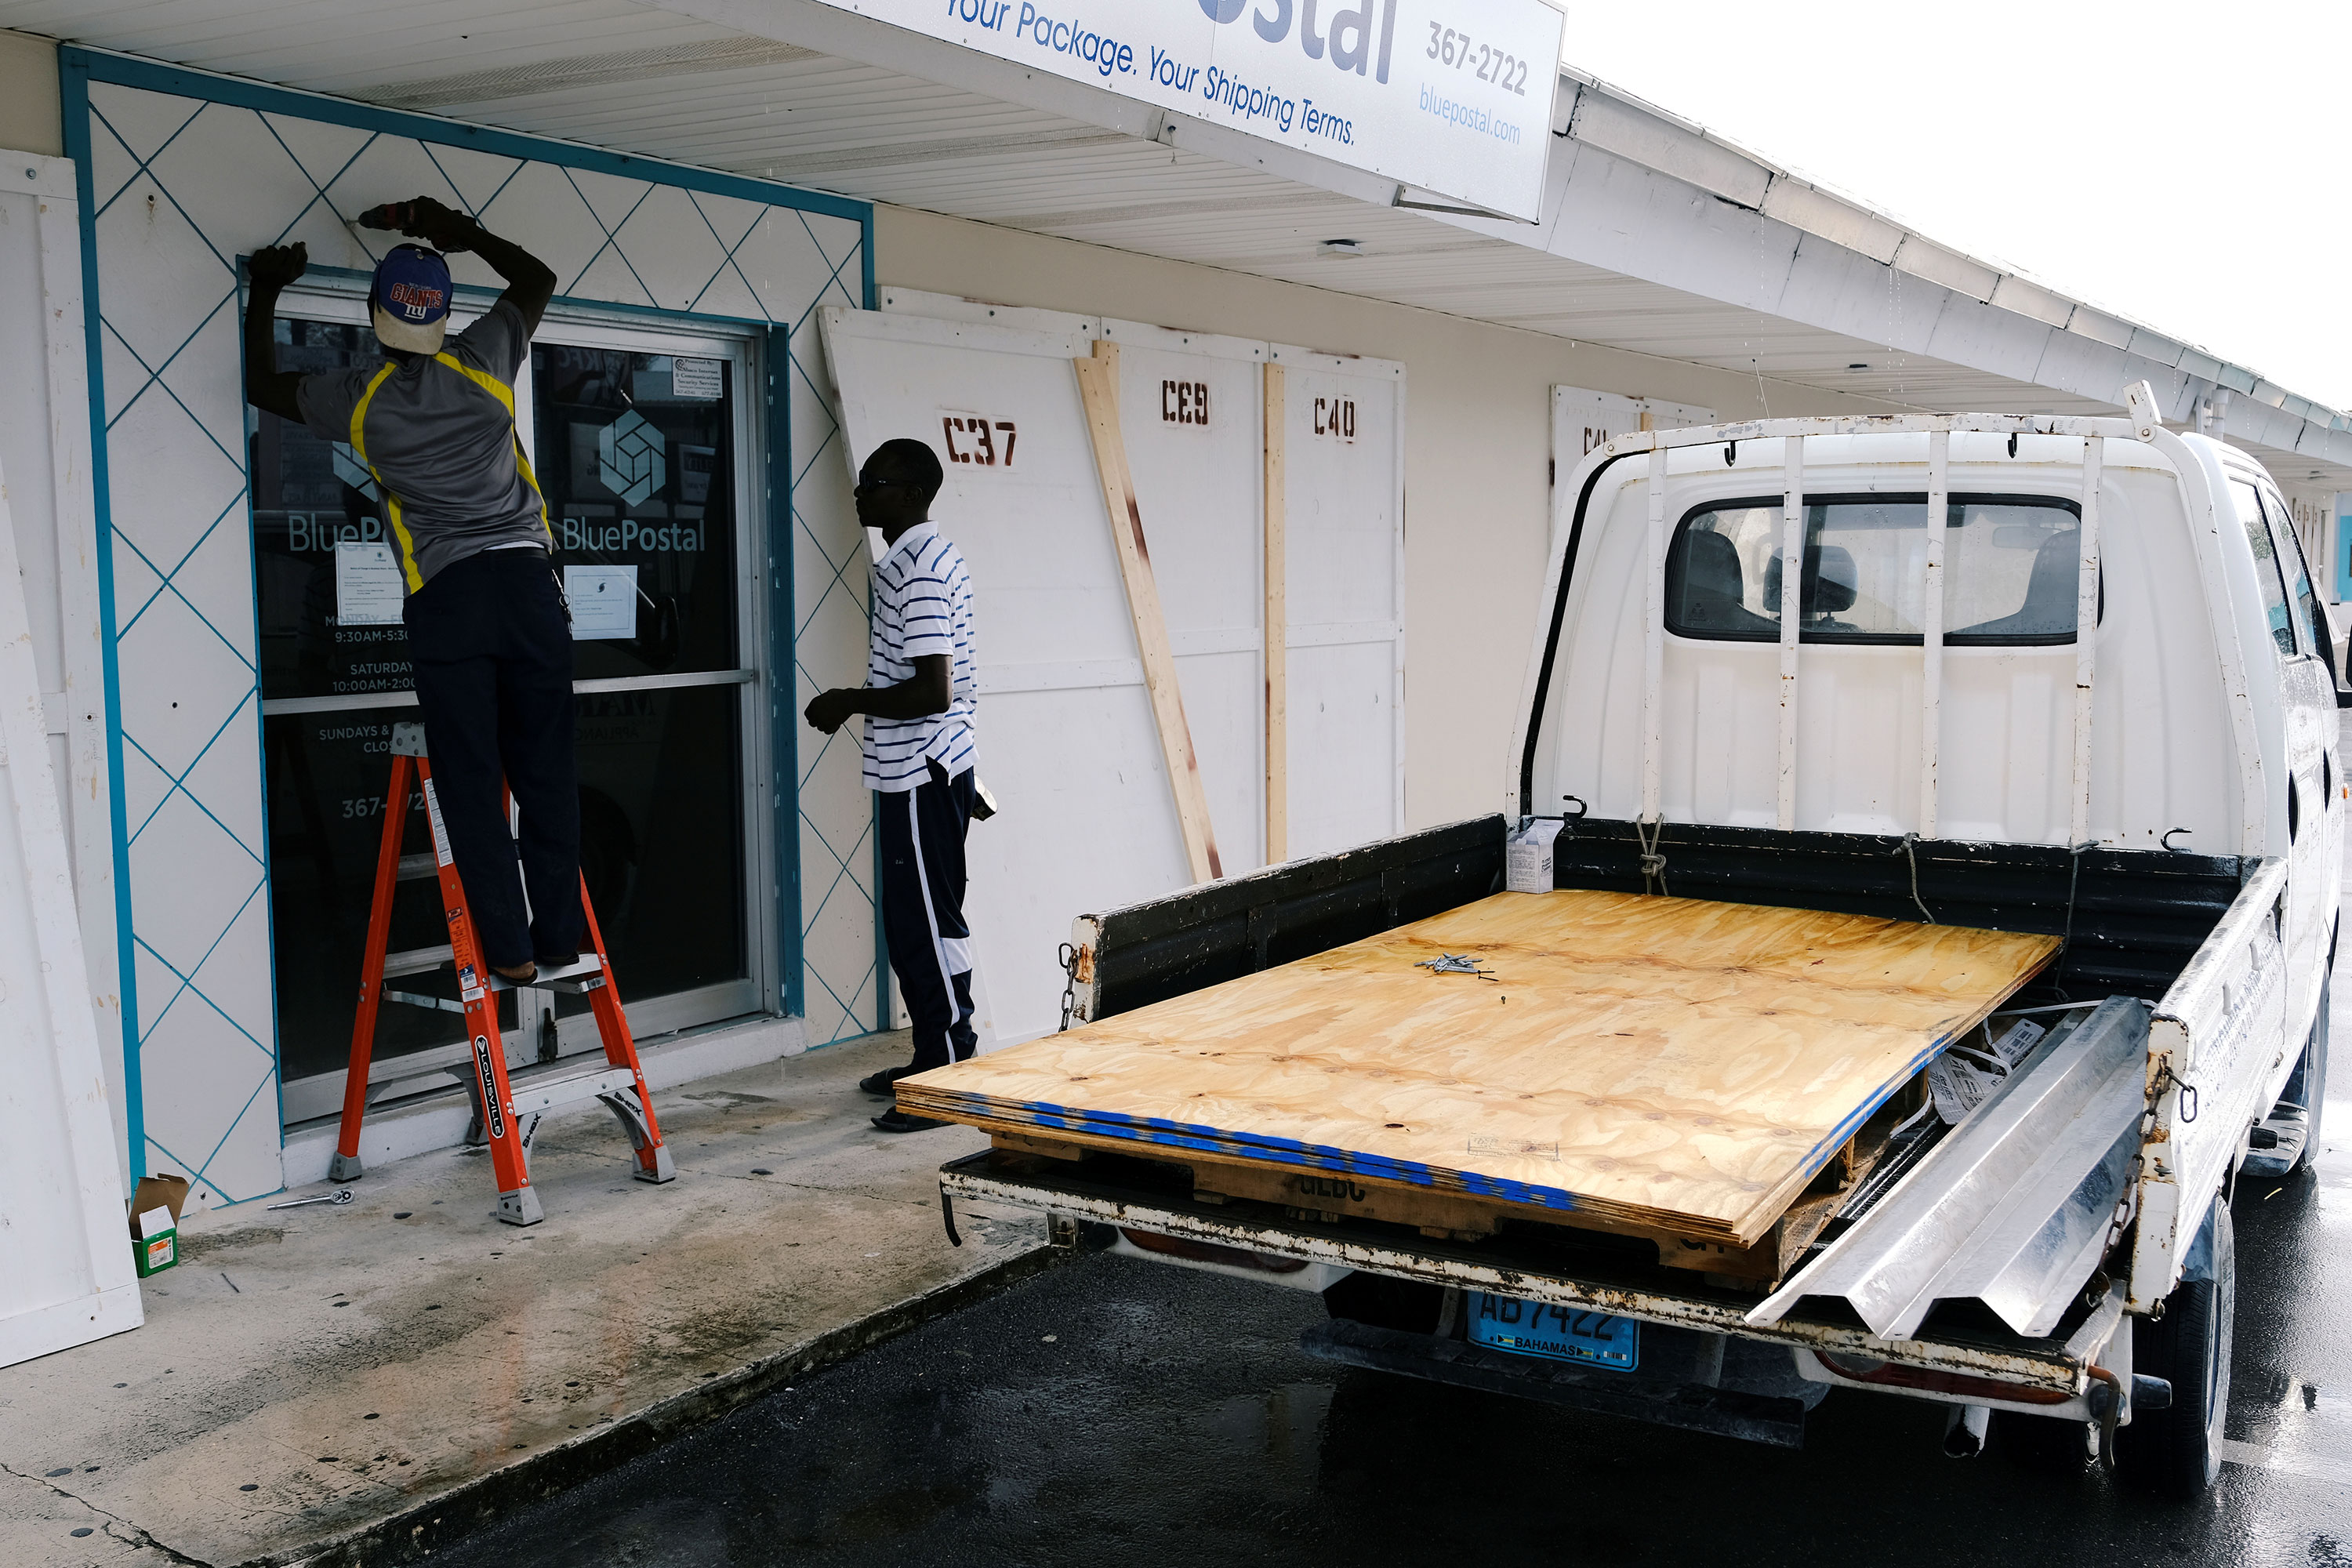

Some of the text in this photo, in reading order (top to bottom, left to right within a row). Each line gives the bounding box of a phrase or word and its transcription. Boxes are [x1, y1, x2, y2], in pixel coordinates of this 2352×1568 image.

[1016, 2, 1137, 77] Package.
[1149, 45, 1200, 93] Your
[1204, 66, 1295, 133] Shipping
[1301, 99, 1354, 146] Terms.
[1426, 20, 1527, 96] 367-2722
[1419, 82, 1520, 145] bluepostal.com
[390, 283, 442, 308] GIANTS
[1314, 397, 1355, 437] C40
[942, 417, 1016, 466] C37
[564, 516, 705, 552] BluePostal
[325, 615, 379, 627] MONDAY
[350, 662, 413, 675] SATURDAY
[319, 725, 390, 740] SUNDAYS &
[481, 1054, 502, 1136] LOUISVILLE
[1515, 1336, 1576, 1356] BAHAMAS
